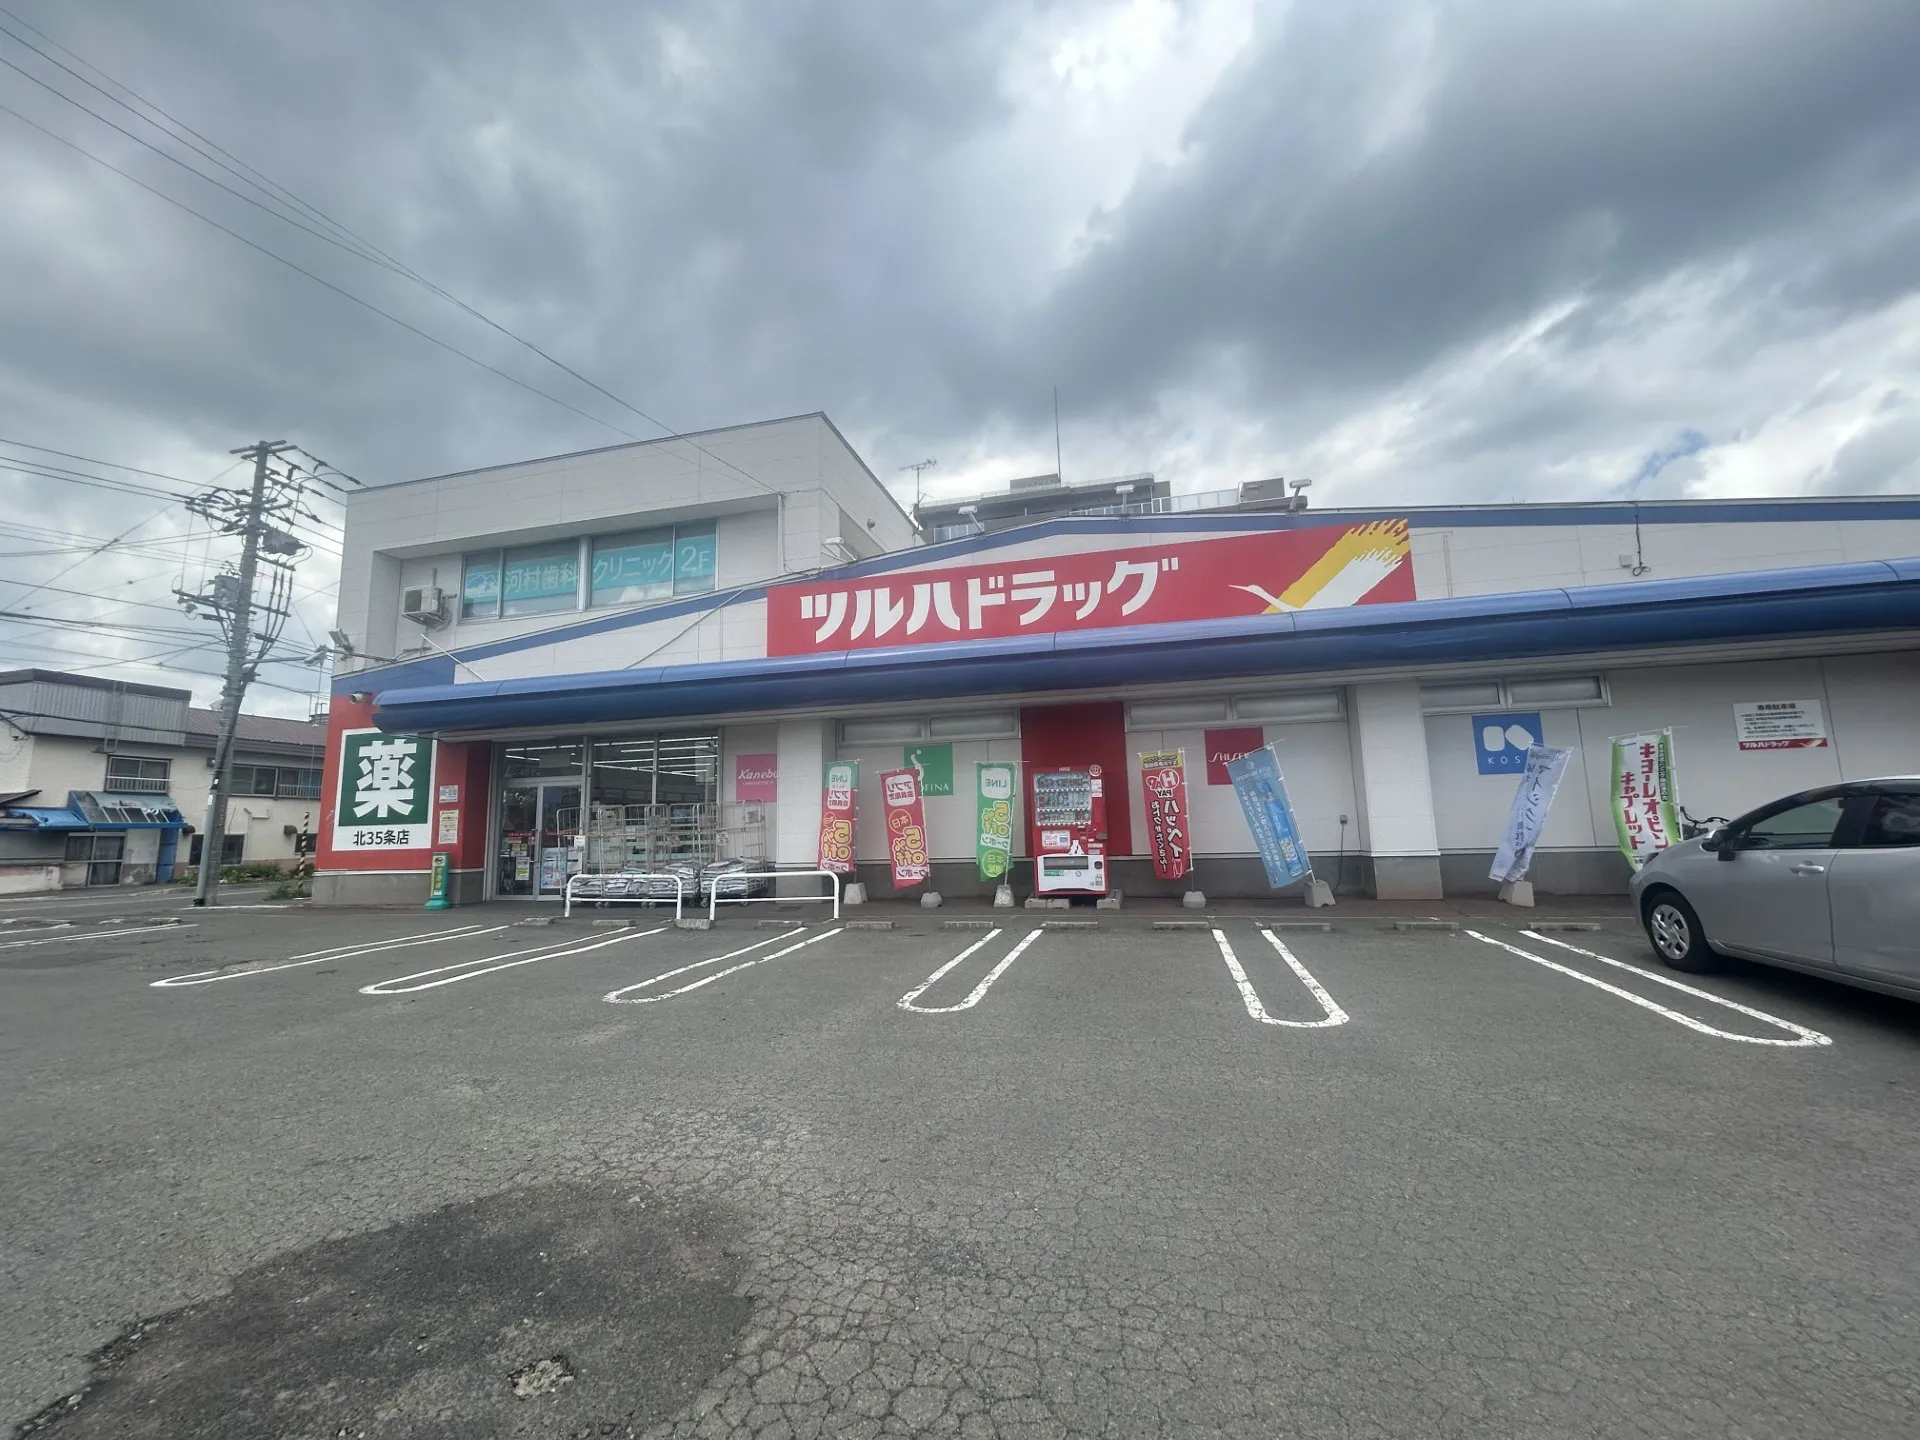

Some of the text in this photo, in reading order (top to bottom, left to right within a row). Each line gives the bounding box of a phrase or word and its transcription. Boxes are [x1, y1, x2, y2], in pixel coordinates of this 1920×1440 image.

[680, 546, 711, 573] 2F
[800, 557, 1179, 644] ツルハドラッグ
[1742, 741, 1790, 749] ツルハドラッグ
[1488, 755, 1521, 765] KOS
[353, 739, 417, 818] 薬
[738, 768, 779, 780] Kanebo
[921, 783, 949, 792] FINA
[1640, 743, 1668, 849] キヨーレオピン
[1619, 771, 1646, 850] キャプレット
[353, 829, 410, 846] 北35条店
